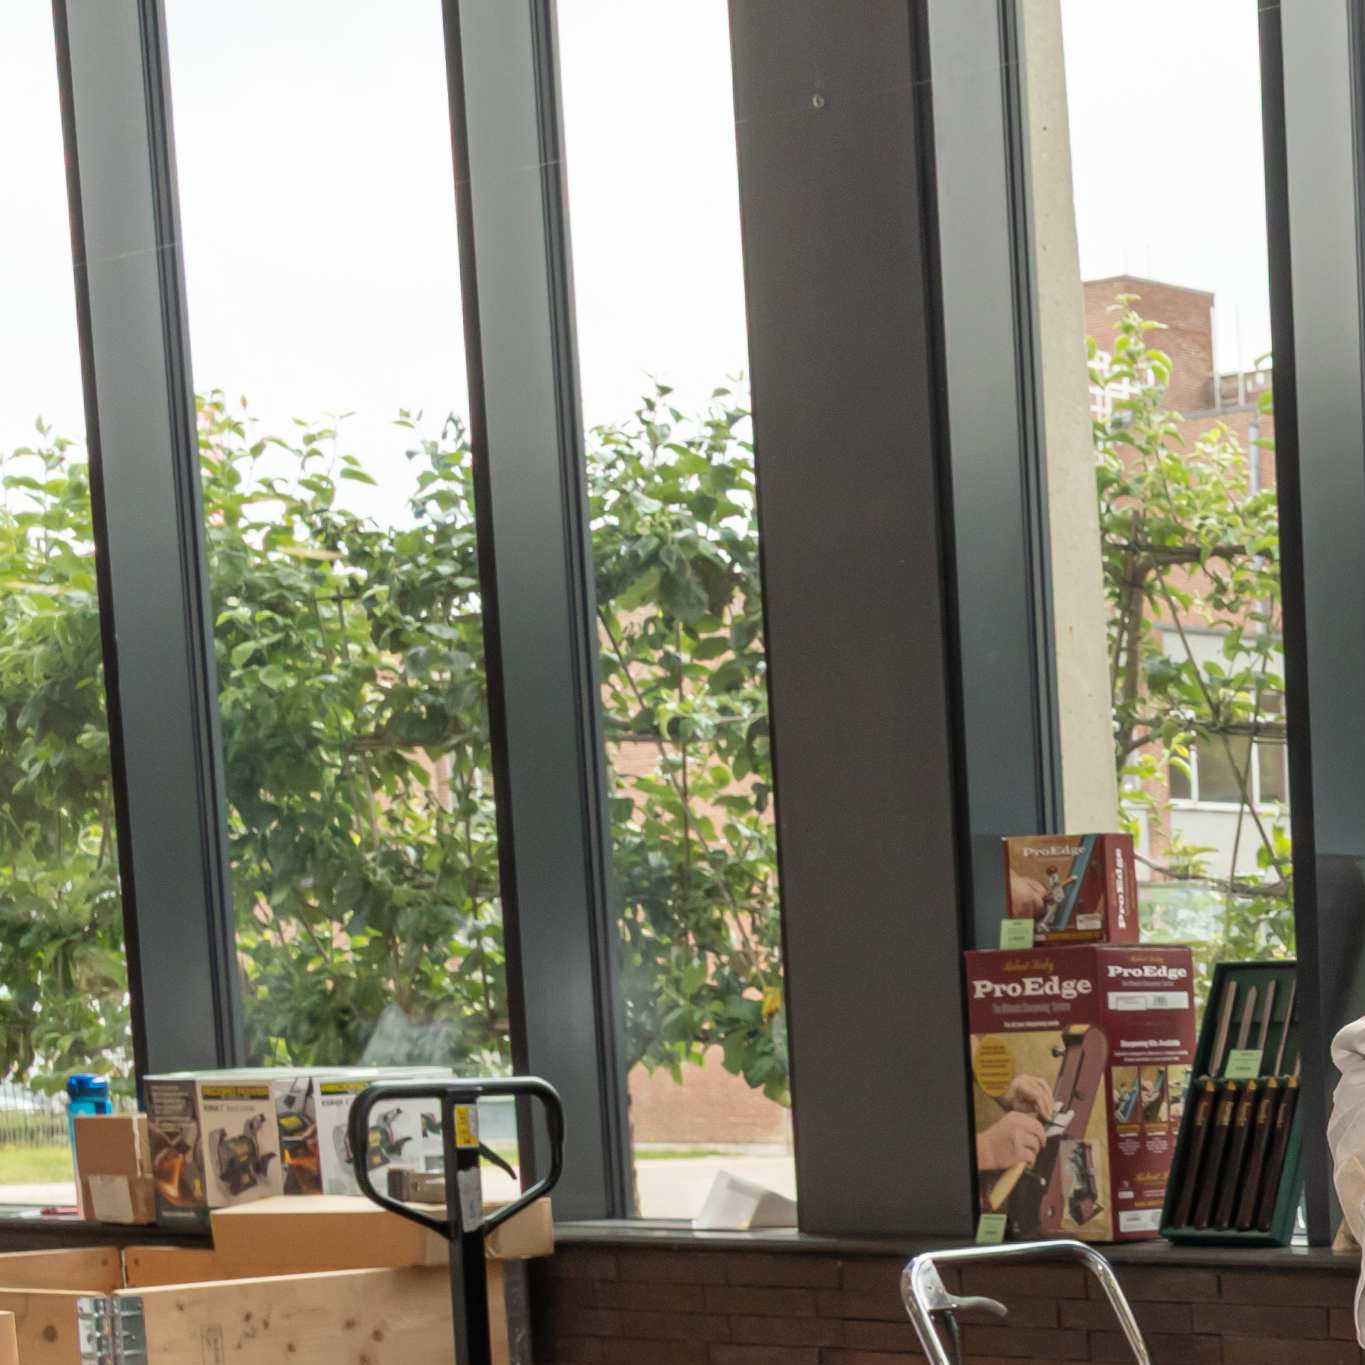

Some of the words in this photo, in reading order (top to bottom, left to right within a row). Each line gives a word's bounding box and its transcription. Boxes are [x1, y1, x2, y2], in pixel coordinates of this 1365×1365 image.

[1022, 845, 1086, 857] ProEdge
[1115, 848, 1127, 929] ProEdge
[1107, 965, 1188, 980] ProEdge
[972, 976, 1093, 999] ProEdge
